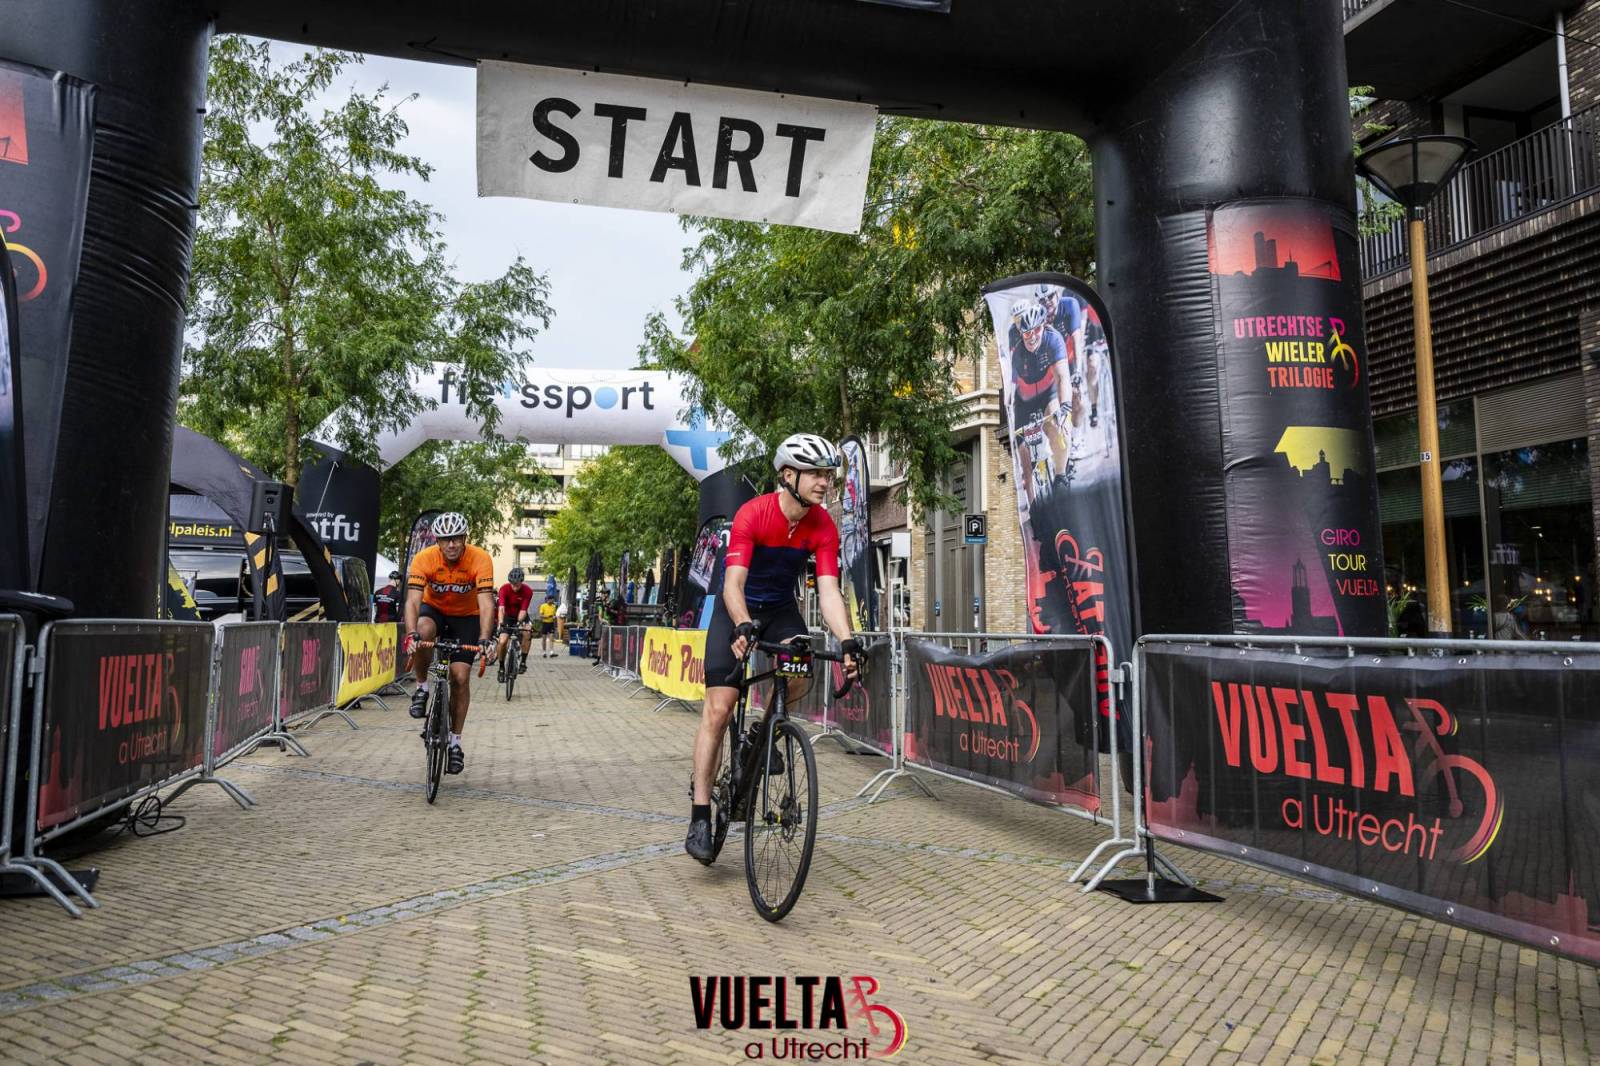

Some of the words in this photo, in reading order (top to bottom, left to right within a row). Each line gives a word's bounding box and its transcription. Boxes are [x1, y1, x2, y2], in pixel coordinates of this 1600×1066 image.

[529, 97, 826, 198] START
[1233, 315, 1325, 338] UTRECHTSE
[1265, 341, 1325, 363] WIELER
[1267, 366, 1335, 388] TRILOGIE
[169, 522, 232, 538] lpaleis.nl
[1321, 528, 1361, 546] GIRO
[1328, 553, 1367, 571] TOUR
[1336, 578, 1379, 596] VUELTA
[782, 662, 809, 672] 2114
[99, 653, 162, 730] VUELTA
[926, 663, 1007, 726] VUELTA
[959, 732, 969, 751] a
[971, 729, 1020, 762] Utrecht
[1211, 681, 1415, 797] VUELTA
[118, 742, 128, 764] a
[1281, 797, 1304, 829] a
[1313, 794, 1444, 860] Utrecht
